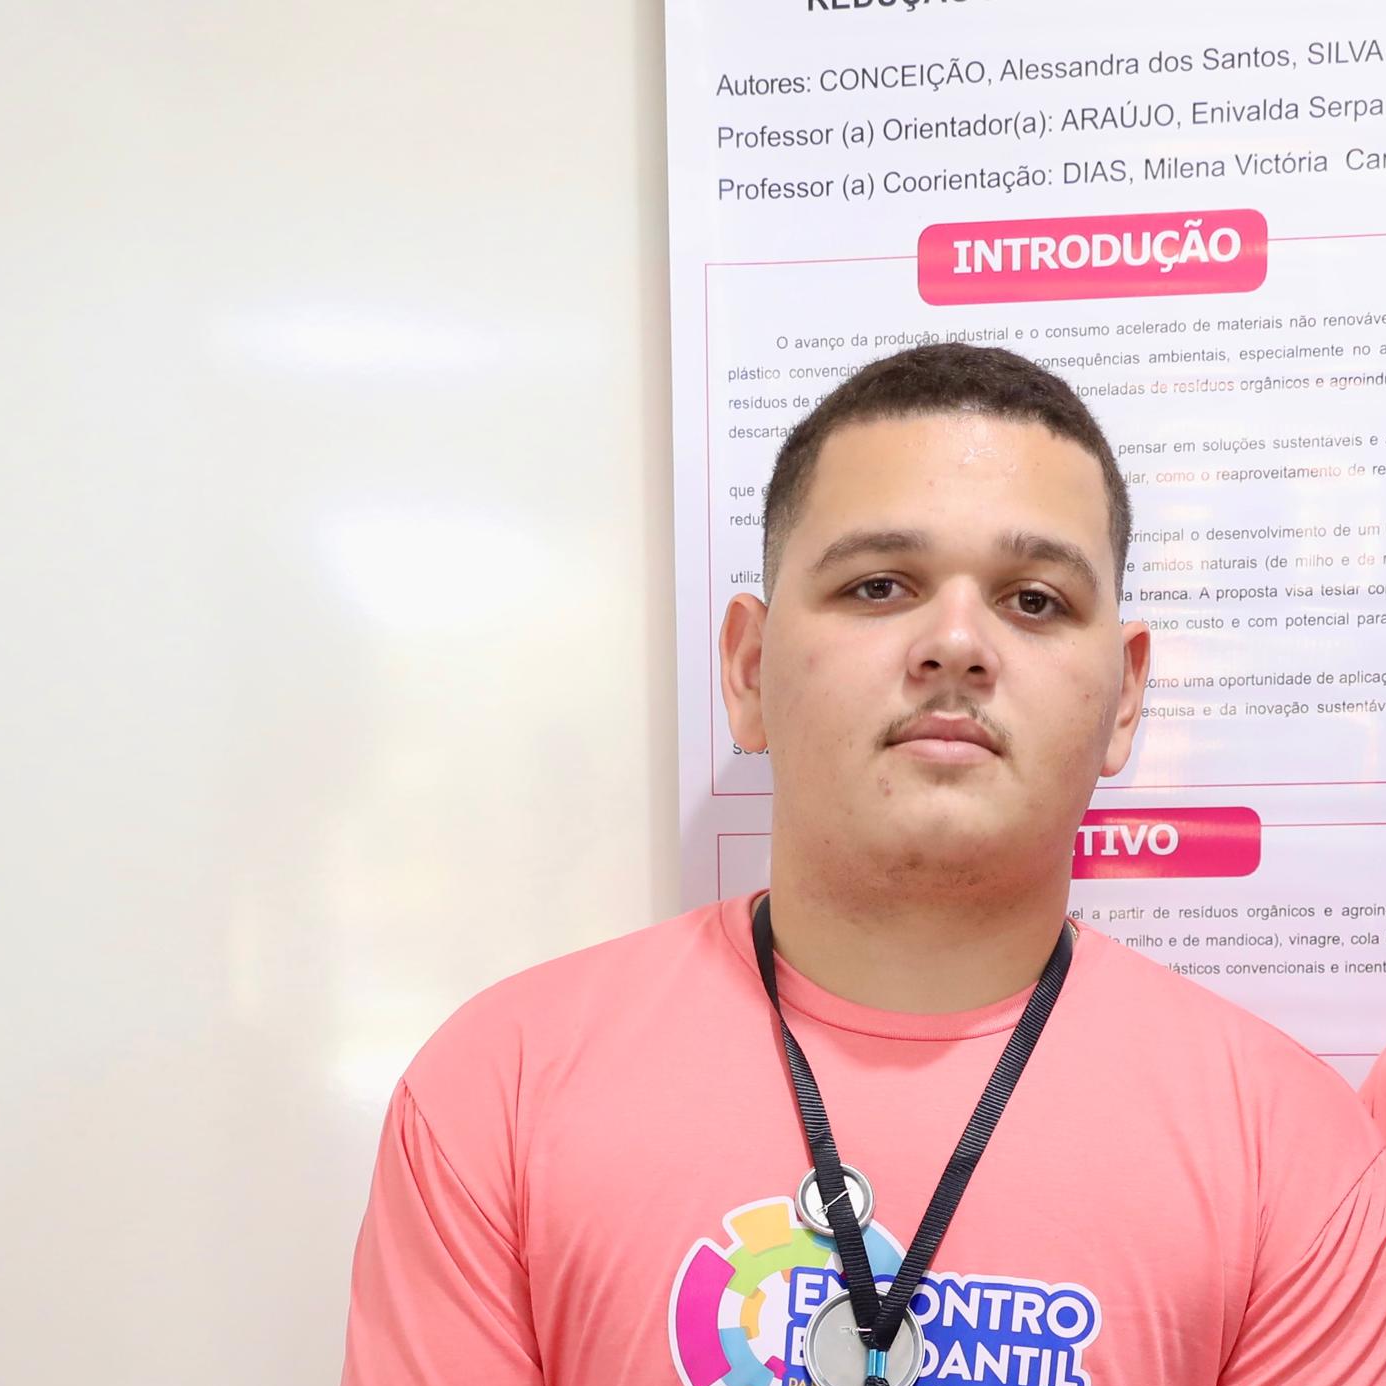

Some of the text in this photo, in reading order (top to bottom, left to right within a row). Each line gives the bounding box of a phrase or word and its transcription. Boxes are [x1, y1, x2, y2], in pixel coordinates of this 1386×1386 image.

[717, 74, 810, 96] Autores:
[820, 58, 991, 91] CONCEIÇÃO,
[1000, 54, 1138, 81] Alessandra
[1149, 51, 1192, 73] dos
[1203, 47, 1296, 70] Santos,
[1308, 40, 1383, 65] SILVA
[718, 125, 834, 148] Professor
[843, 120, 874, 149] (a)
[883, 111, 1052, 141] Orientador(a):
[1061, 101, 1180, 131] ARAÚJO,
[1193, 98, 1298, 124] Enivalda
[1309, 96, 1383, 122] Serpa
[719, 178, 834, 200] Professor
[843, 173, 874, 201] (a)
[884, 166, 1052, 193] Coorientação:
[1064, 160, 1133, 184] DIAS,
[1145, 157, 1225, 180] Milena
[1235, 151, 1327, 175] Victória
[953, 218, 1241, 273] INTRODUÇÃO
[795, 337, 845, 351] avanço
[874, 331, 940, 348] produção
[946, 327, 1009, 343] industrial
[1045, 325, 1109, 338] consumo
[1116, 320, 1186, 335] acelerado
[1217, 316, 1282, 330] materiais
[728, 367, 780, 383] plástico
[1149, 349, 1229, 364] ambientais,
[1240, 344, 1344, 362] especialmente
[729, 396, 787, 409] resíduos
[1240, 376, 1309, 393] orgânicos
[1118, 443, 1167, 458] pensar
[1203, 438, 1266, 454] soluções
[1273, 436, 1362, 449] sustentáveis
[1217, 466, 1341, 483] reaproveitamento
[1206, 526, 1326, 540] desenvolvimento
[1140, 589, 1191, 601] branca.
[1216, 586, 1277, 602] proposta
[1286, 612, 1349, 630] potencial
[1219, 672, 1312, 690] oportunidade
[1245, 701, 1309, 717] inovação
[1072, 824, 1179, 856] TIVO
[1179, 905, 1238, 918] resíduos
[1247, 905, 1315, 920] orgânicos
[1126, 934, 1163, 947] milho
[1206, 933, 1282, 948] mandioca),
[1289, 936, 1344, 948] vinagre,
[1226, 961, 1325, 974] convencionais
[795, 1273, 1089, 1338] EONTRO
